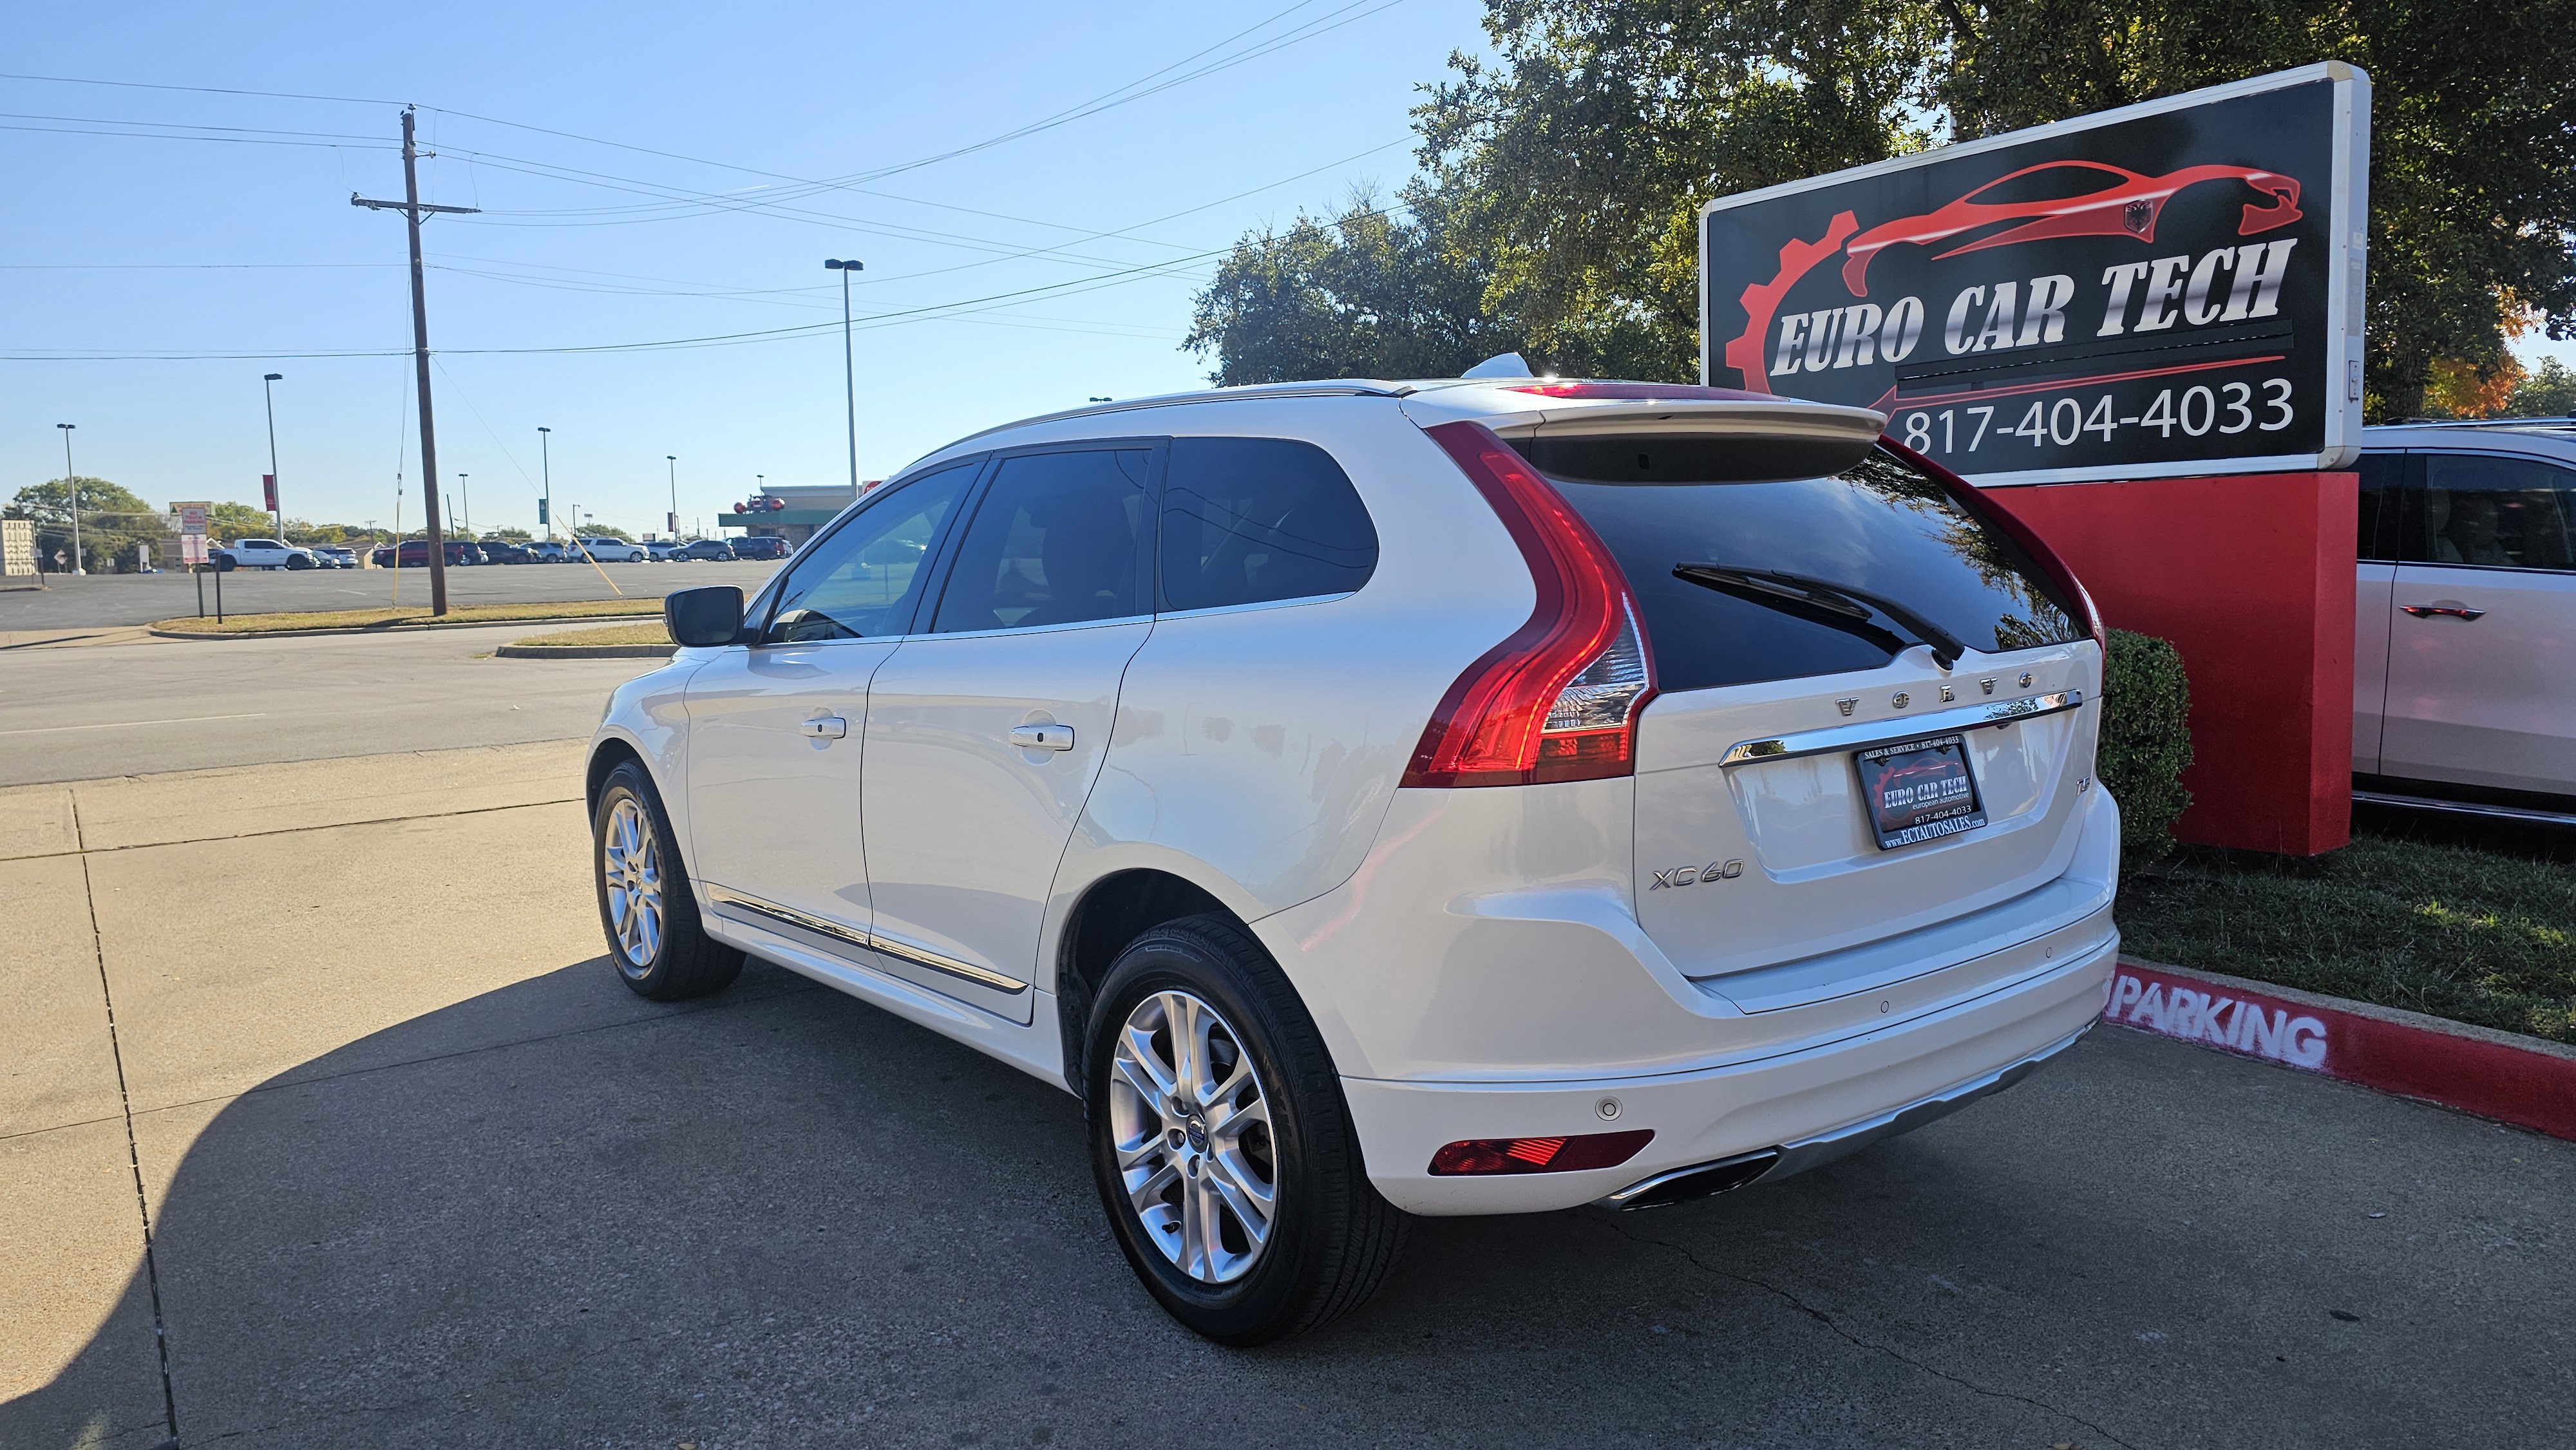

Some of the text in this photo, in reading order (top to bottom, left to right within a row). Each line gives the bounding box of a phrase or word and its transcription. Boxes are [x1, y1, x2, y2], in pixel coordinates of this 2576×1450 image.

[1770, 296, 1925, 377] EURO
[1944, 273, 2075, 355] CAR
[2096, 238, 2298, 338] TECH
[1904, 377, 2294, 456] 817-404-4033
[1835, 672, 2032, 717] VOLVO
[1864, 749, 1884, 760] SALES
[1889, 743, 1916, 755] SERVICE
[1921, 735, 1959, 749] 817-404-4033
[1884, 775, 1968, 809] EURO CAR TECH
[1912, 791, 1970, 811] european automotive
[1915, 805, 1972, 825] 817-404-4033
[1884, 816, 1985, 849] www.ECTAUTOSALES.com
[2105, 975, 2327, 1070] PARKING
